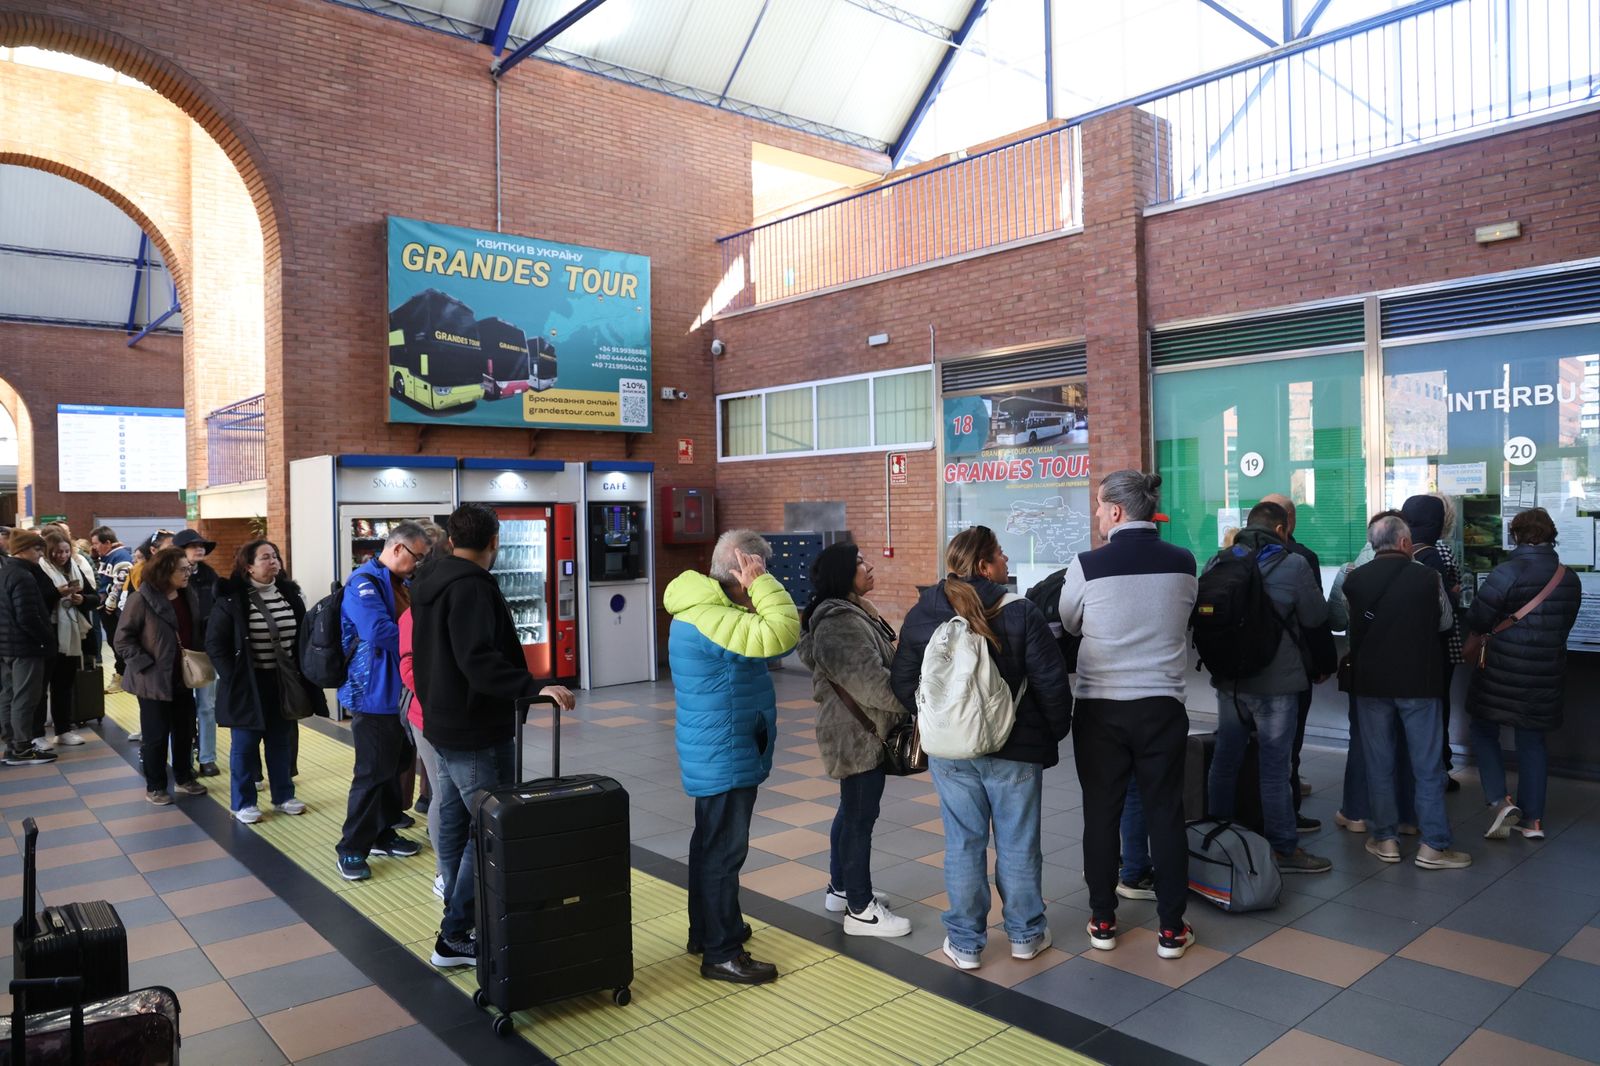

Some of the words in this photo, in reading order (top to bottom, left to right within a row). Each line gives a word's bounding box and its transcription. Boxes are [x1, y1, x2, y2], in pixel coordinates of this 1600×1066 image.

[476, 238, 525, 254] КВИТКИ
[526, 245, 536, 255] В
[537, 246, 584, 263] УКРАЇНУ
[401, 242, 551, 288] GRANDES
[565, 265, 639, 299] TOUR
[434, 330, 468, 345] GRANDES
[622, 382, 646, 390] -10%
[528, 394, 585, 405] Бронювання
[586, 397, 618, 407] онлайн
[1448, 381, 1600, 413] INTERBUS
[528, 406, 616, 418] grandestour.com.ua
[952, 414, 974, 436] 18
[1509, 443, 1533, 460] 20
[944, 458, 1033, 484] GRANDES
[1244, 458, 1259, 473] 19
[372, 477, 418, 490] SNACK'S
[602, 480, 628, 491] CAFÉ
